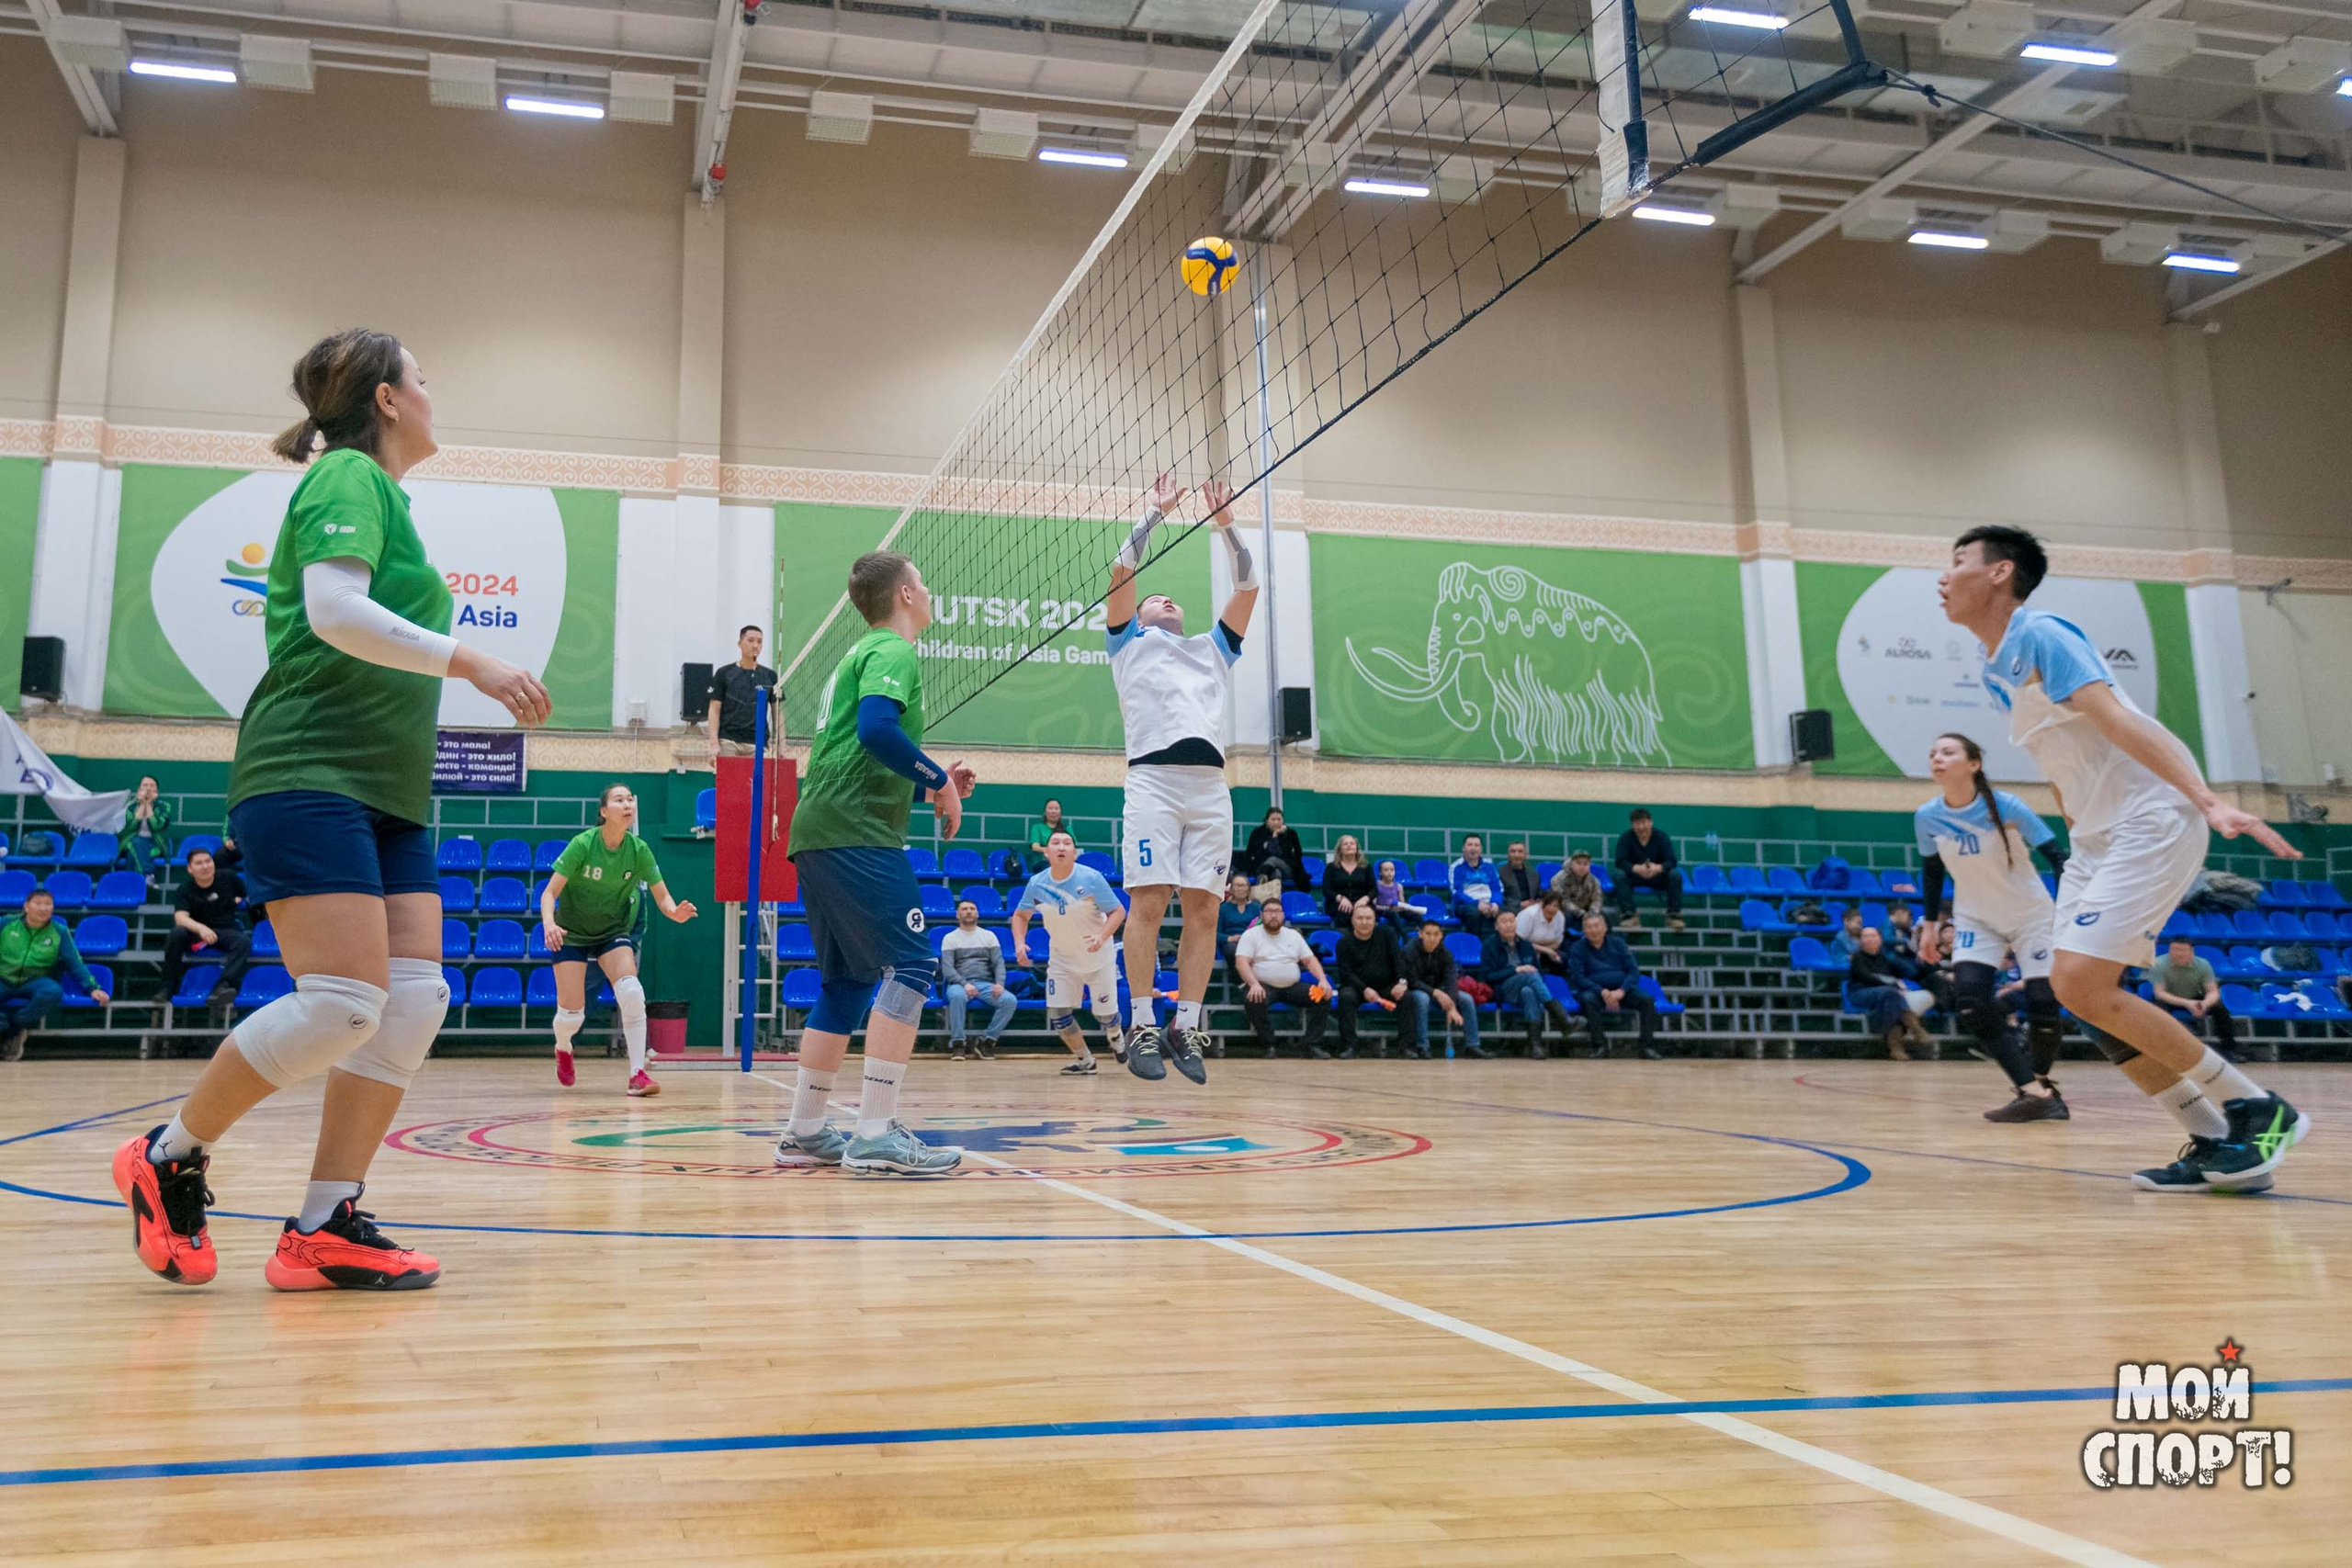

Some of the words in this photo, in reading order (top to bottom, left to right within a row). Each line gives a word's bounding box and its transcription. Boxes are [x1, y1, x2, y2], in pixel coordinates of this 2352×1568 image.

[446, 572, 519, 596] 2024
[458, 604, 518, 628] Asia
[929, 595, 1031, 627] UTSK
[1040, 599, 1108, 631] 202
[914, 638, 988, 660] hildren
[991, 642, 1013, 660] of
[1017, 644, 1060, 663] Asia
[1065, 645, 1110, 664] Gam
[443, 740, 459, 749] это
[461, 741, 491, 750] мало!
[486, 752, 516, 761] хило!
[468, 762, 516, 772] команда!
[489, 773, 515, 782] сила!
[1139, 839, 1152, 867] 5
[1954, 832, 1980, 856] 20
[583, 864, 603, 881] 18
[1058, 899, 1066, 915] 8
